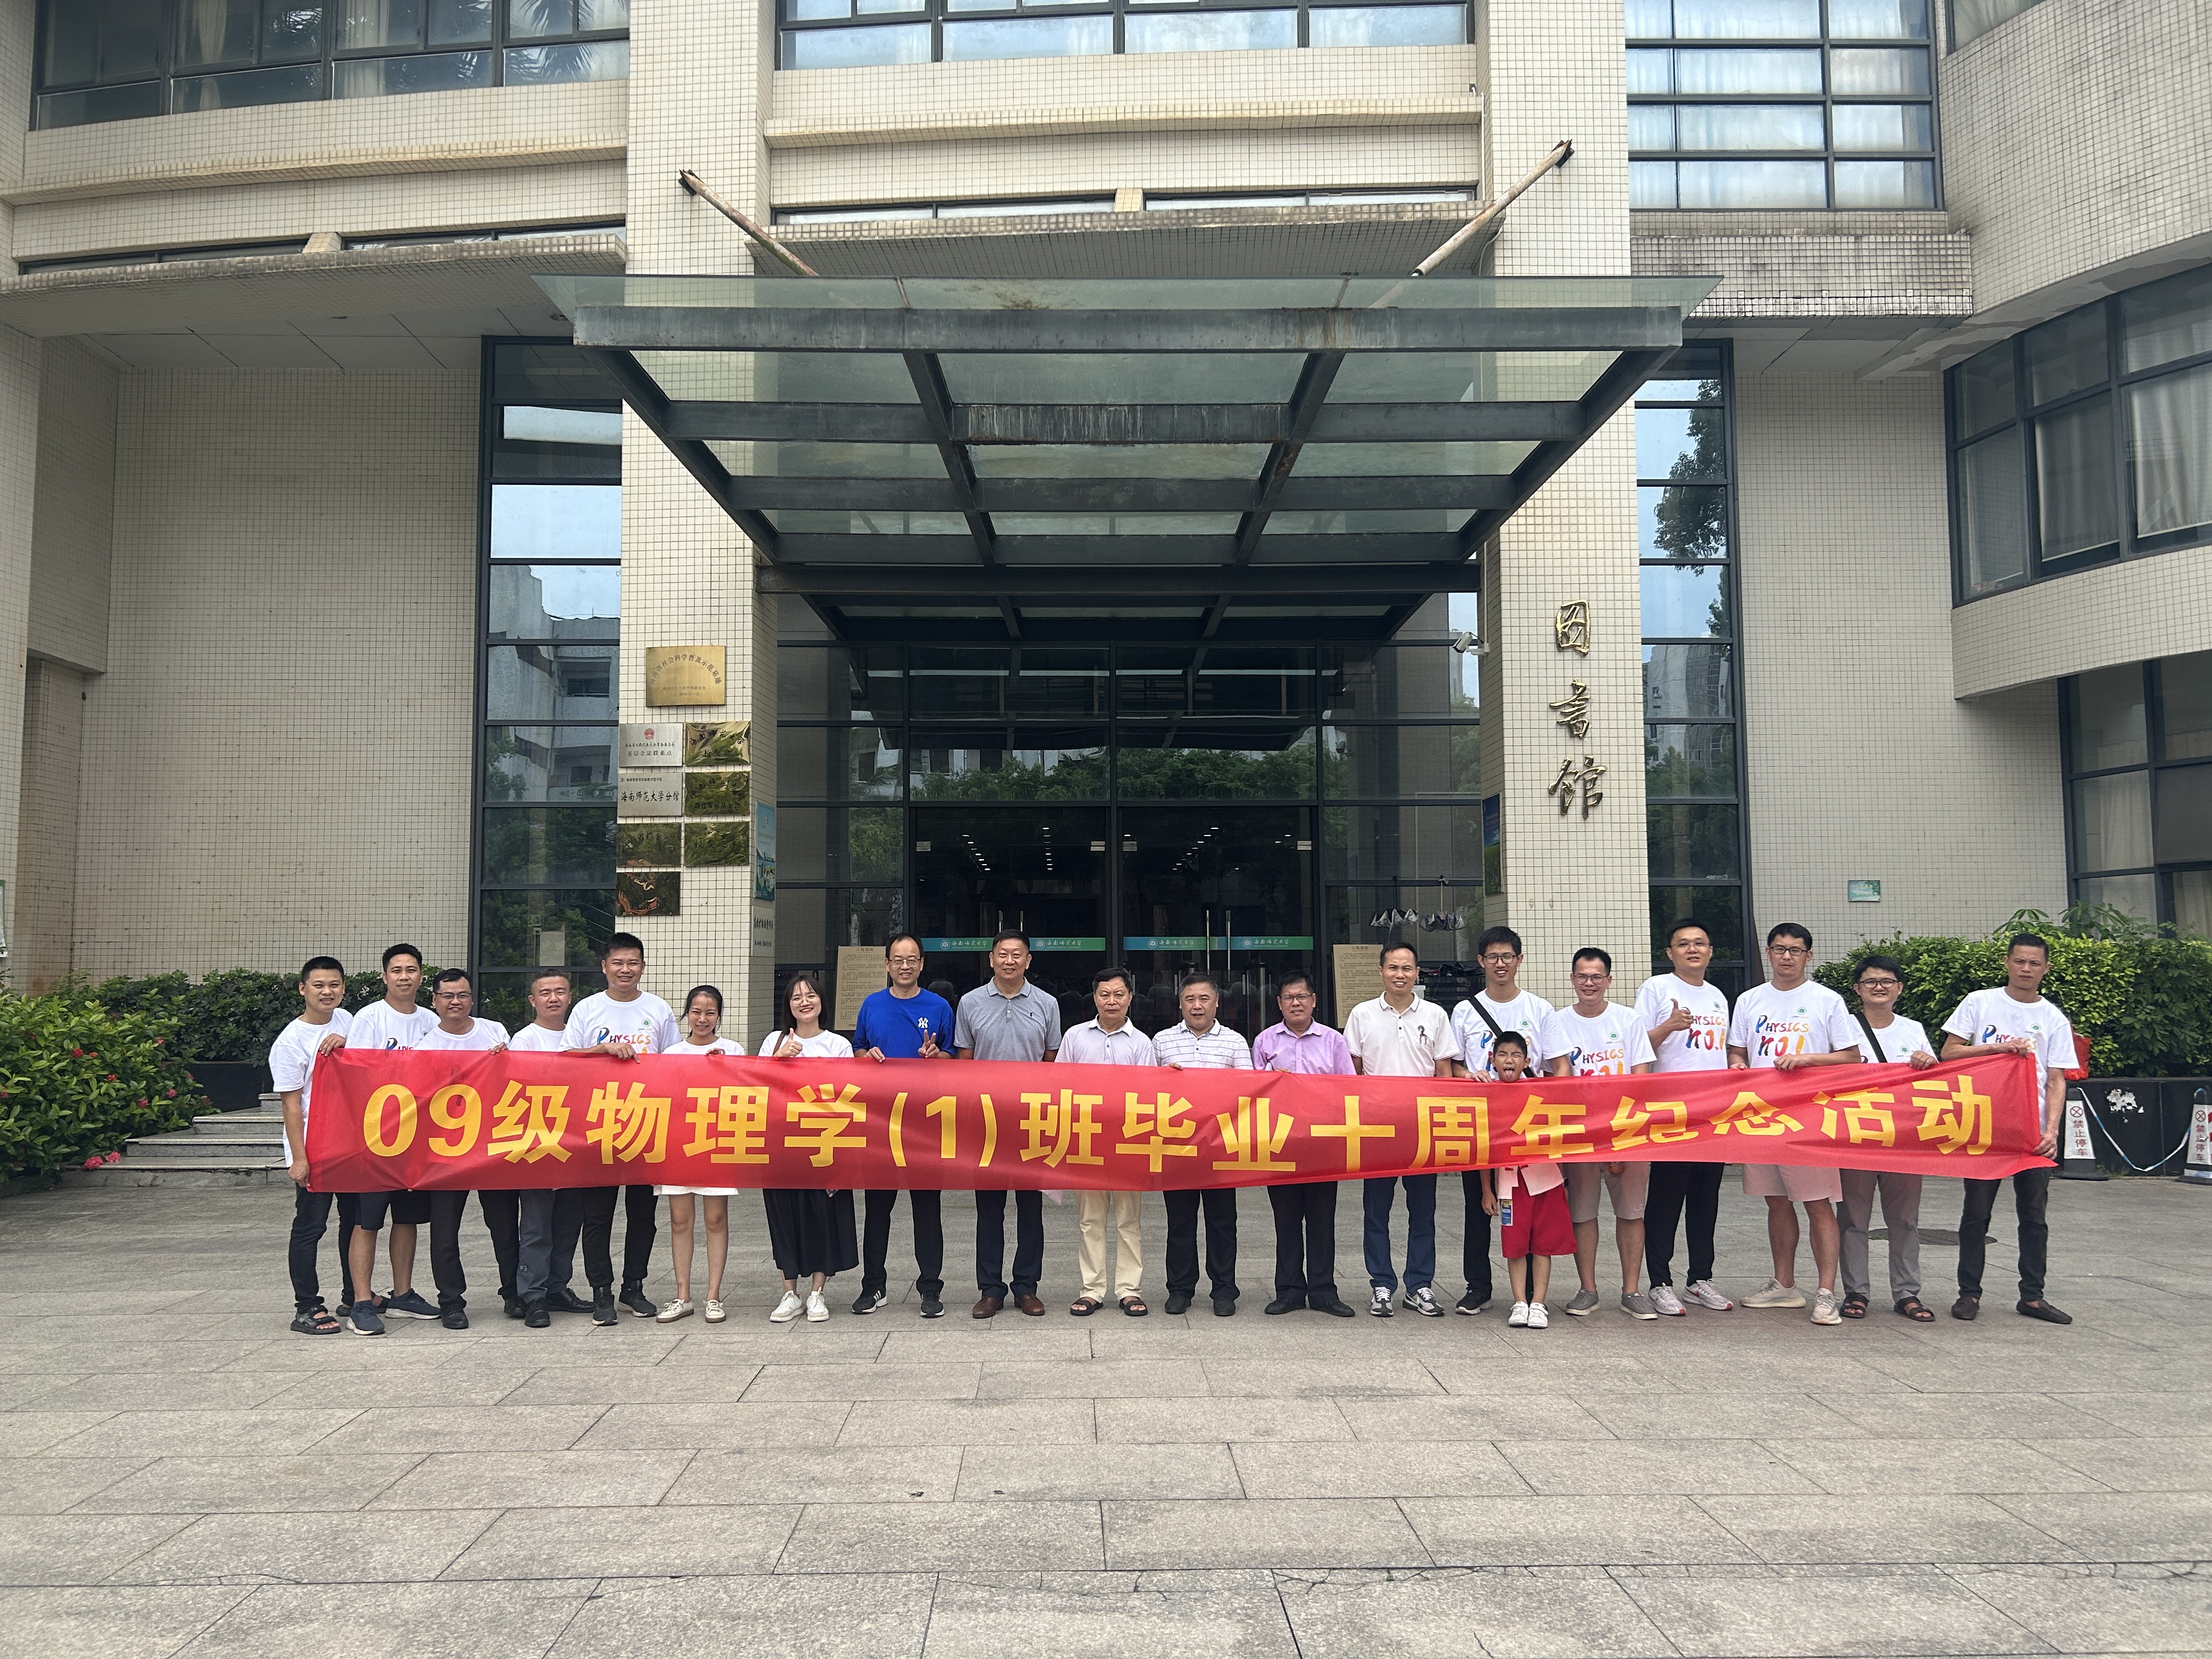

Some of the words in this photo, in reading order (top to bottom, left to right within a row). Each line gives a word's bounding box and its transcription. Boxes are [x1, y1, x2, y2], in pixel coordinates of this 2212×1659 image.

[621, 791, 680, 803] 海南师范大学分馆
[1681, 1007, 1726, 1026] HYSICS
[1756, 1015, 1809, 1034] PHYSICS
[597, 1027, 651, 1045] PHYSICS
[1571, 1046, 1624, 1066] PHYSICS
[2073, 1120, 2087, 1156] 禁止停车
[2196, 1125, 2205, 1161] 禁止停车
